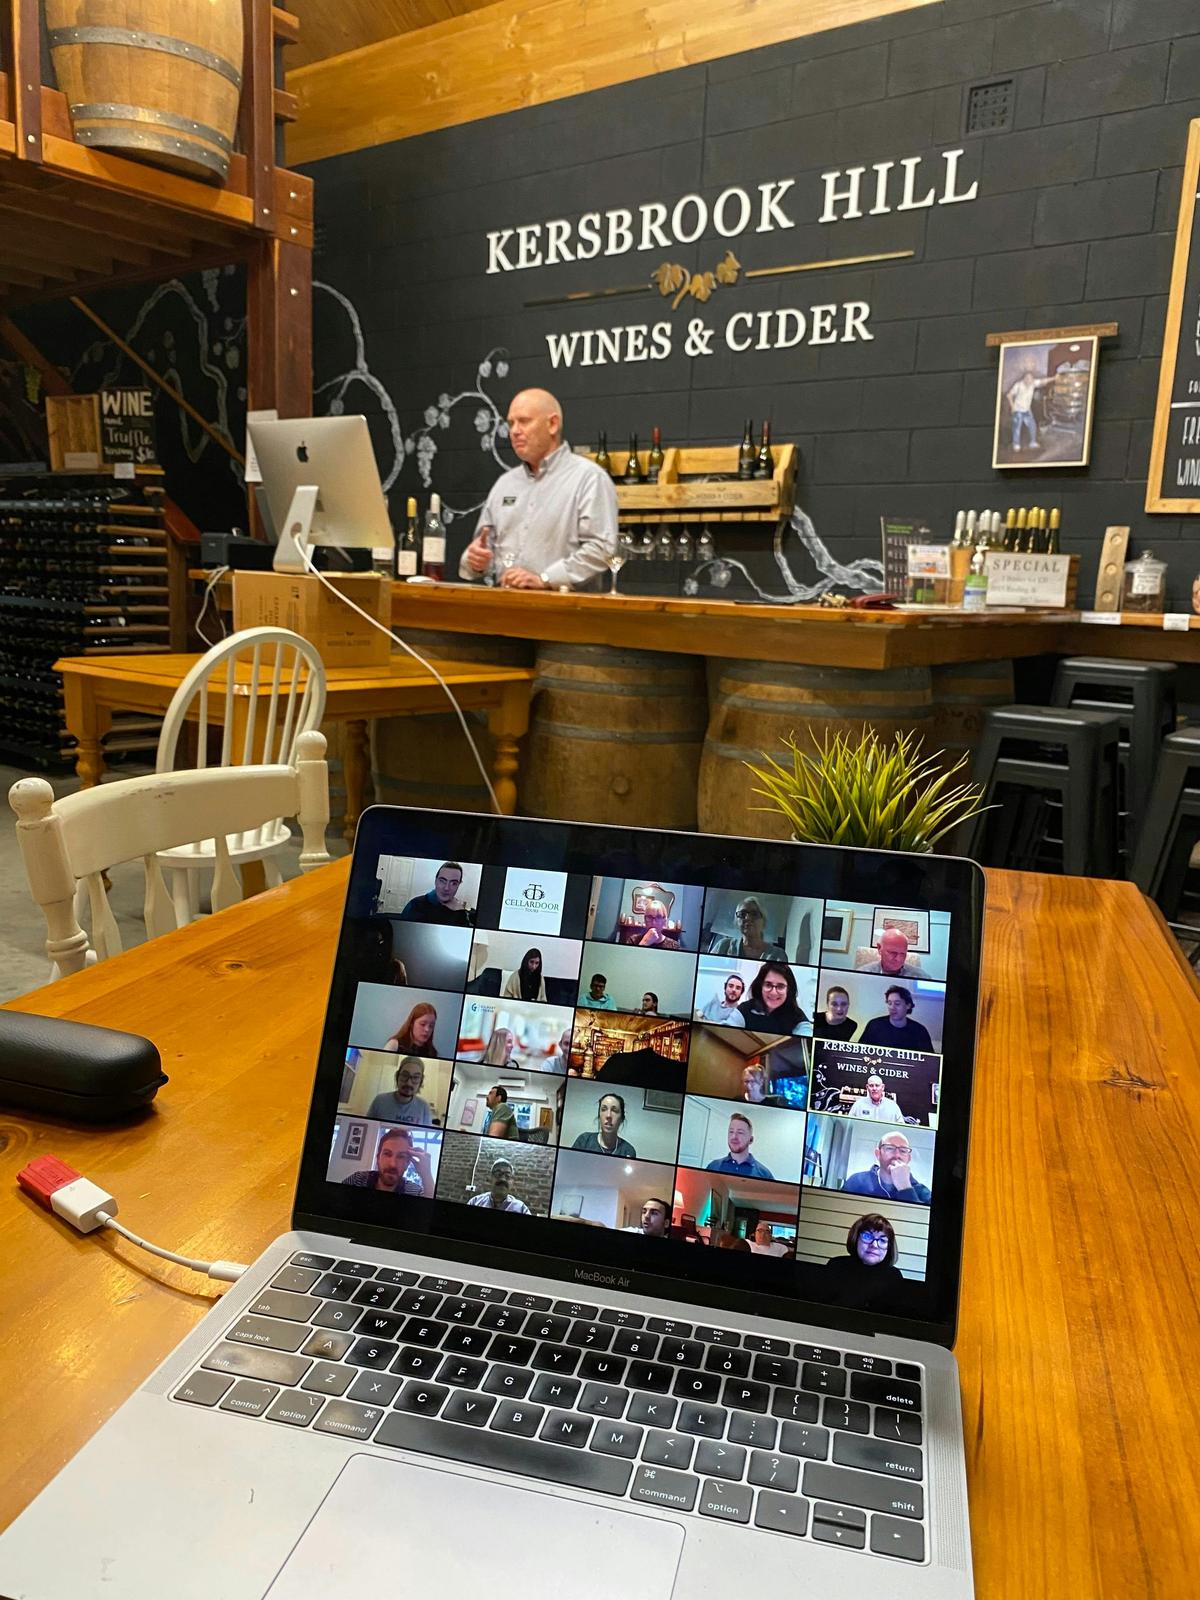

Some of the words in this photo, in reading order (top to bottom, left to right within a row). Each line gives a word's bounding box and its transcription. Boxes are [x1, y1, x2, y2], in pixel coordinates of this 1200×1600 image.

[485, 179, 796, 275] KERSBROOK
[818, 148, 979, 225] HILL
[545, 321, 673, 369] WINES
[684, 317, 713, 358] &
[725, 300, 875, 352] CIDER
[102, 391, 153, 416] WINE
[106, 427, 152, 447] Truffle
[993, 559, 1060, 573] SPECIAL
[504, 899, 559, 910] CELLARDOOR
[823, 1041, 893, 1058] KERSBROOK
[896, 1050, 925, 1062] HILL
[837, 1062, 868, 1074] WINES
[878, 1068, 910, 1078] CIDER
[574, 1268, 616, 1285] MacBook
[618, 1276, 630, 1286] Air
[333, 1312, 343, 1320] Q
[235, 1331, 252, 1340] caps
[324, 1341, 333, 1349] A
[508, 1345, 516, 1354] T
[368, 1350, 377, 1358] S
[553, 1354, 561, 1362] Y
[210, 1357, 230, 1368] shift
[412, 1358, 421, 1367] D
[598, 1363, 608, 1371] U
[325, 1374, 336, 1383] Z
[504, 1377, 514, 1385] G
[370, 1383, 381, 1392] X
[551, 1386, 561, 1395] H
[692, 1381, 702, 1390] O
[417, 1393, 427, 1402] C
[742, 1390, 750, 1398] P
[230, 1398, 261, 1410] control
[600, 1396, 608, 1404] J
[886, 1394, 914, 1405] delete
[466, 1403, 475, 1412] V
[648, 1406, 656, 1414] K
[279, 1408, 307, 1420] option
[513, 1413, 522, 1421] B
[698, 1415, 705, 1424] L
[324, 1419, 367, 1434] command
[562, 1423, 572, 1433] N
[611, 1433, 623, 1443] M
[772, 1458, 779, 1468] ?
[884, 1460, 916, 1474] return
[638, 1486, 686, 1503] command
[707, 1501, 739, 1515] option
[892, 1501, 916, 1512] shift
